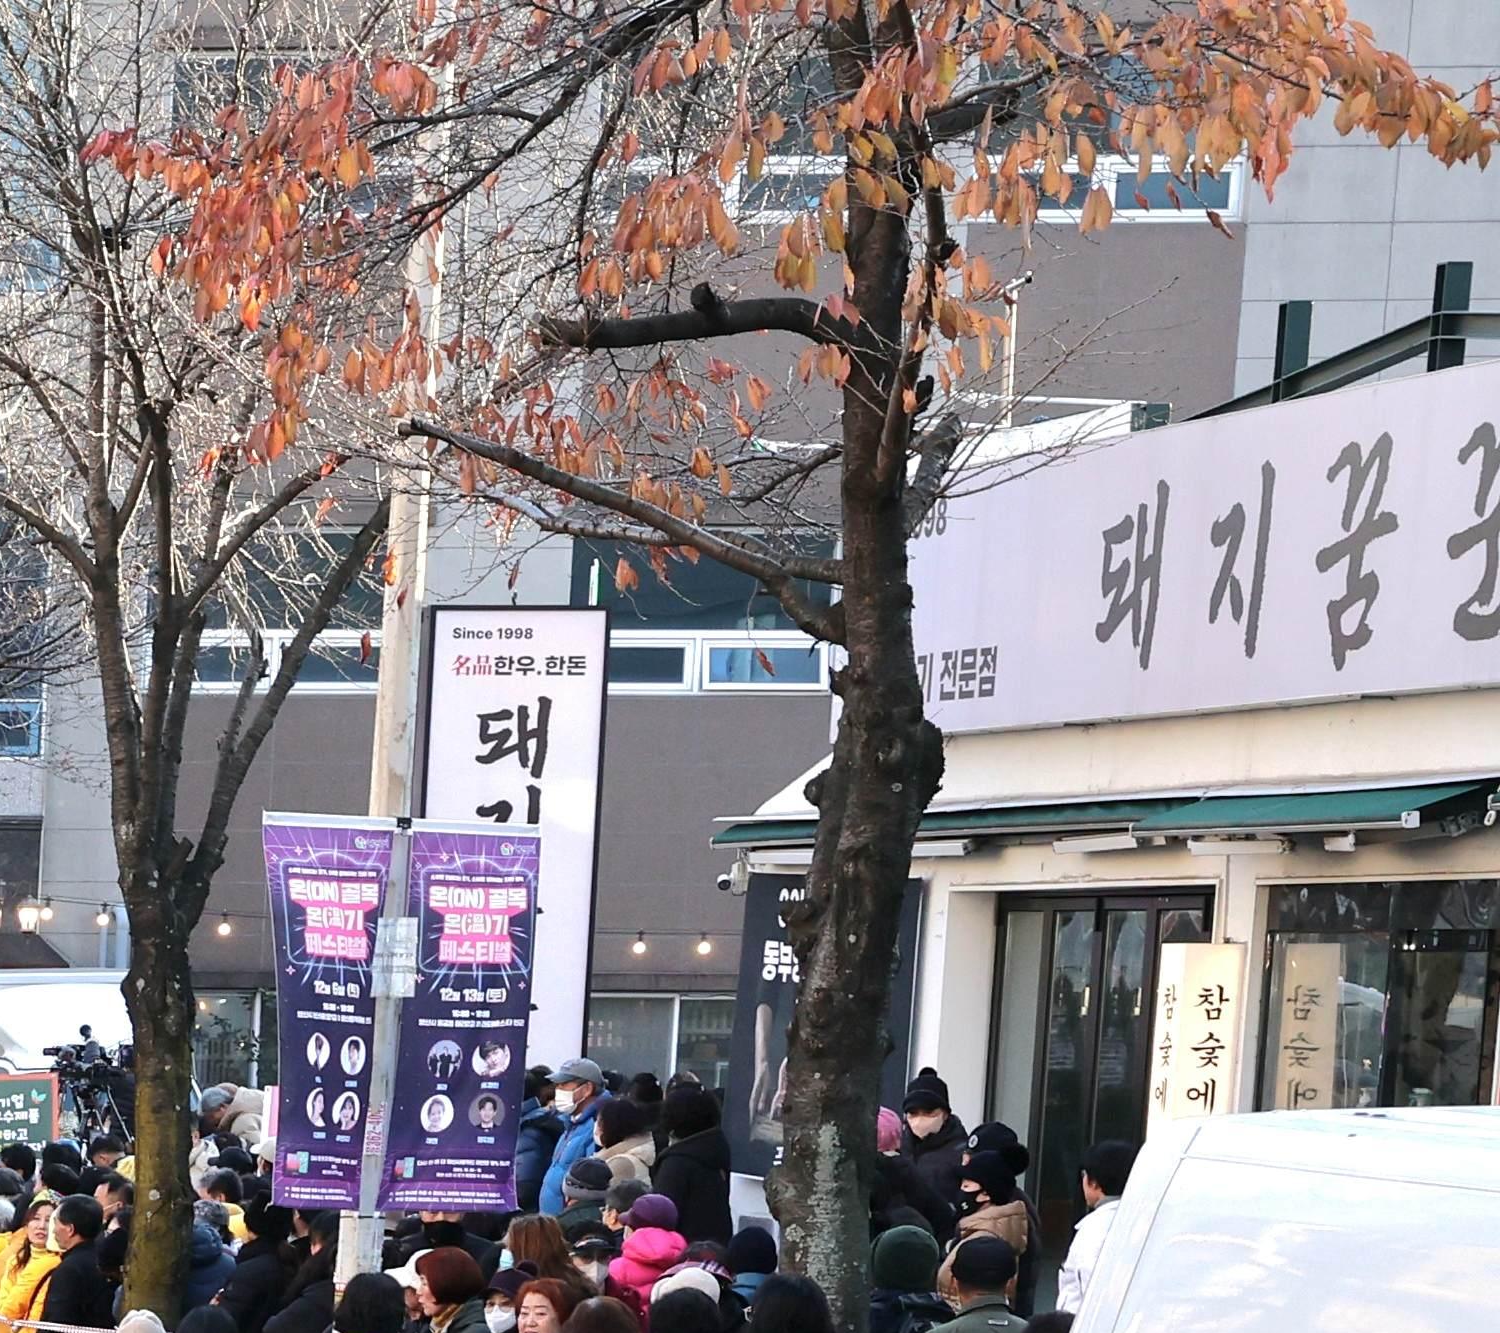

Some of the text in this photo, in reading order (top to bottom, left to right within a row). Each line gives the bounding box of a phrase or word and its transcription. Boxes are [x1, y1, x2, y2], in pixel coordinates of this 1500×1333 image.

[452, 627, 534, 640] Since 1998
[940, 644, 998, 701] 전문점
[430, 885, 527, 909] 온(ON) 골목
[439, 941, 512, 964] 페스티벌
[1186, 984, 1230, 1113] 참숯에
